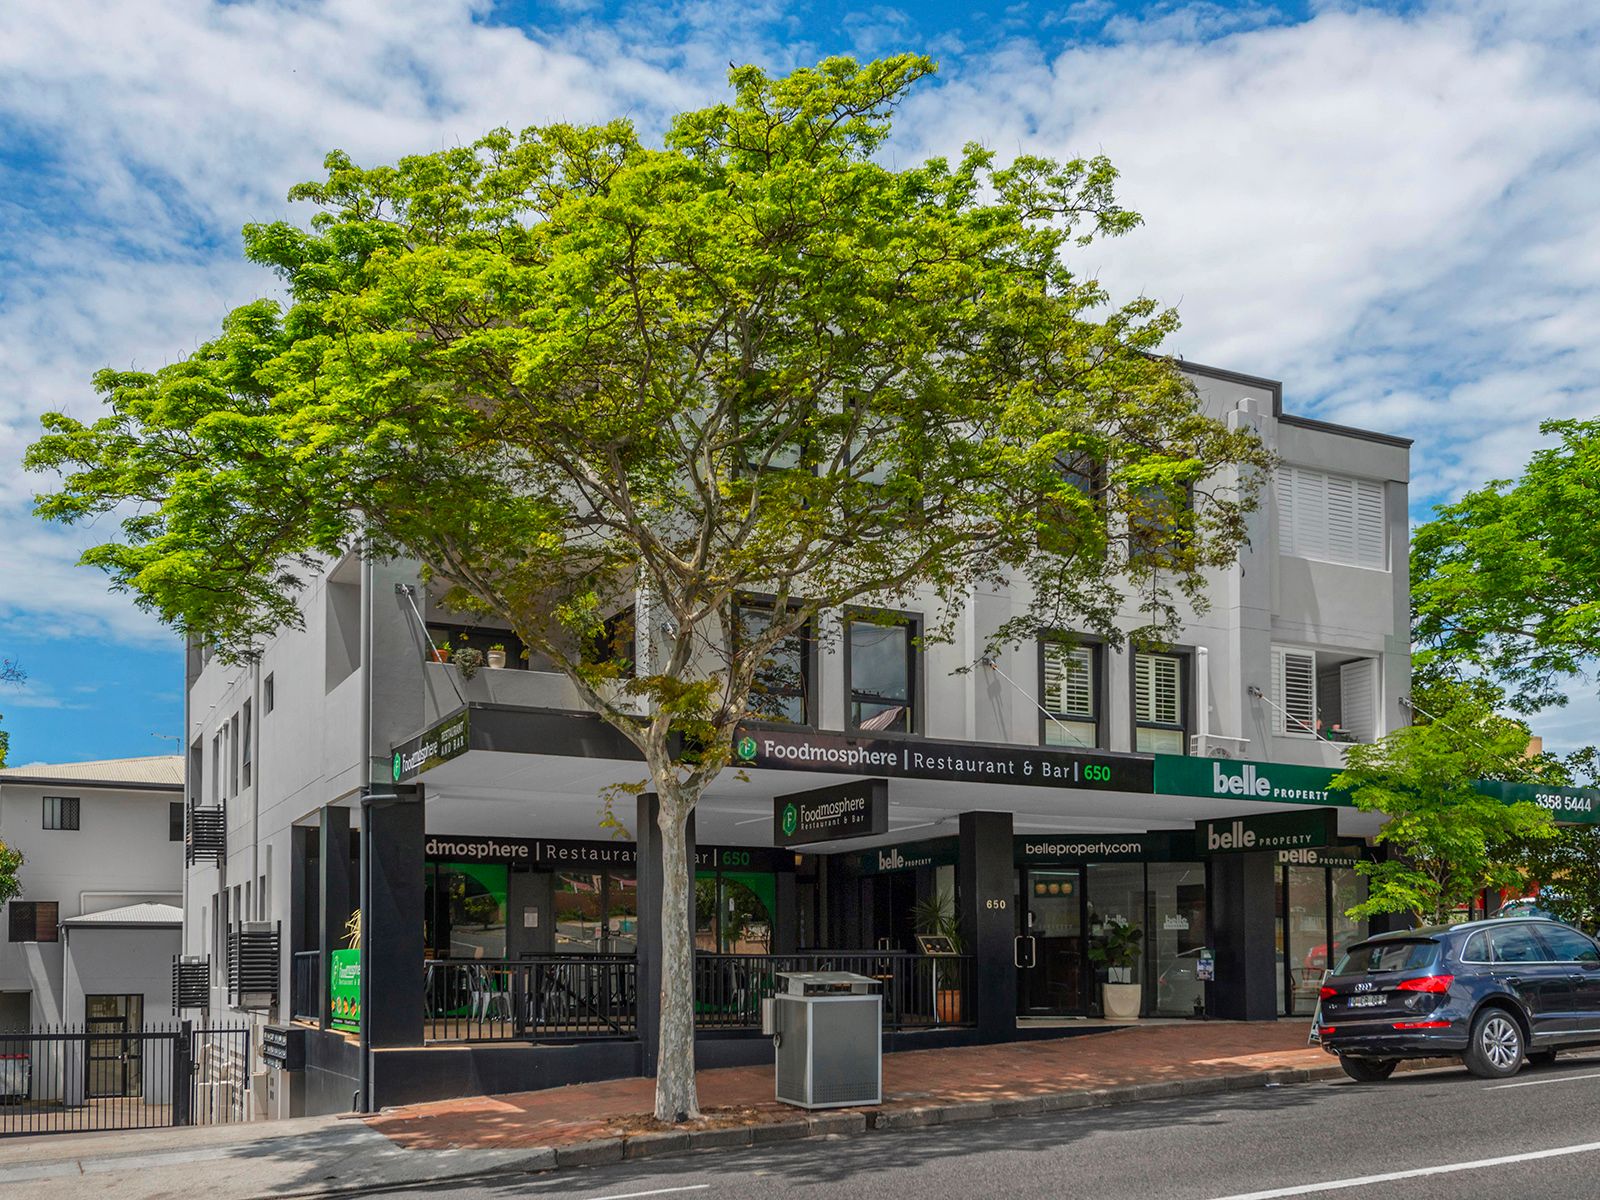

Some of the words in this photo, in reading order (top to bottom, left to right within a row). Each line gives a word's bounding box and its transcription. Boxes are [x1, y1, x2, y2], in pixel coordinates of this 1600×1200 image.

[402, 741, 438, 772] Foodmosphere
[764, 740, 897, 766] Foodmosphere
[914, 752, 1015, 775] Restaurant
[1023, 760, 1033, 776] &
[1042, 762, 1070, 778] Bar
[1084, 765, 1111, 781] 650
[1213, 762, 1271, 796] belle
[1274, 788, 1328, 800] PROPERTY
[800, 797, 865, 823] Foodmosphere
[1535, 793, 1562, 810] 3358
[1564, 796, 1591, 812] 5444
[801, 818, 841, 830] Restaurant
[852, 814, 865, 823] Bar
[1208, 821, 1256, 850] belle
[1259, 834, 1312, 847] PROPERTY
[722, 851, 750, 866] 650
[878, 849, 904, 871] belle
[1025, 842, 1142, 856] belleproperty.com
[986, 899, 1006, 910] 650
